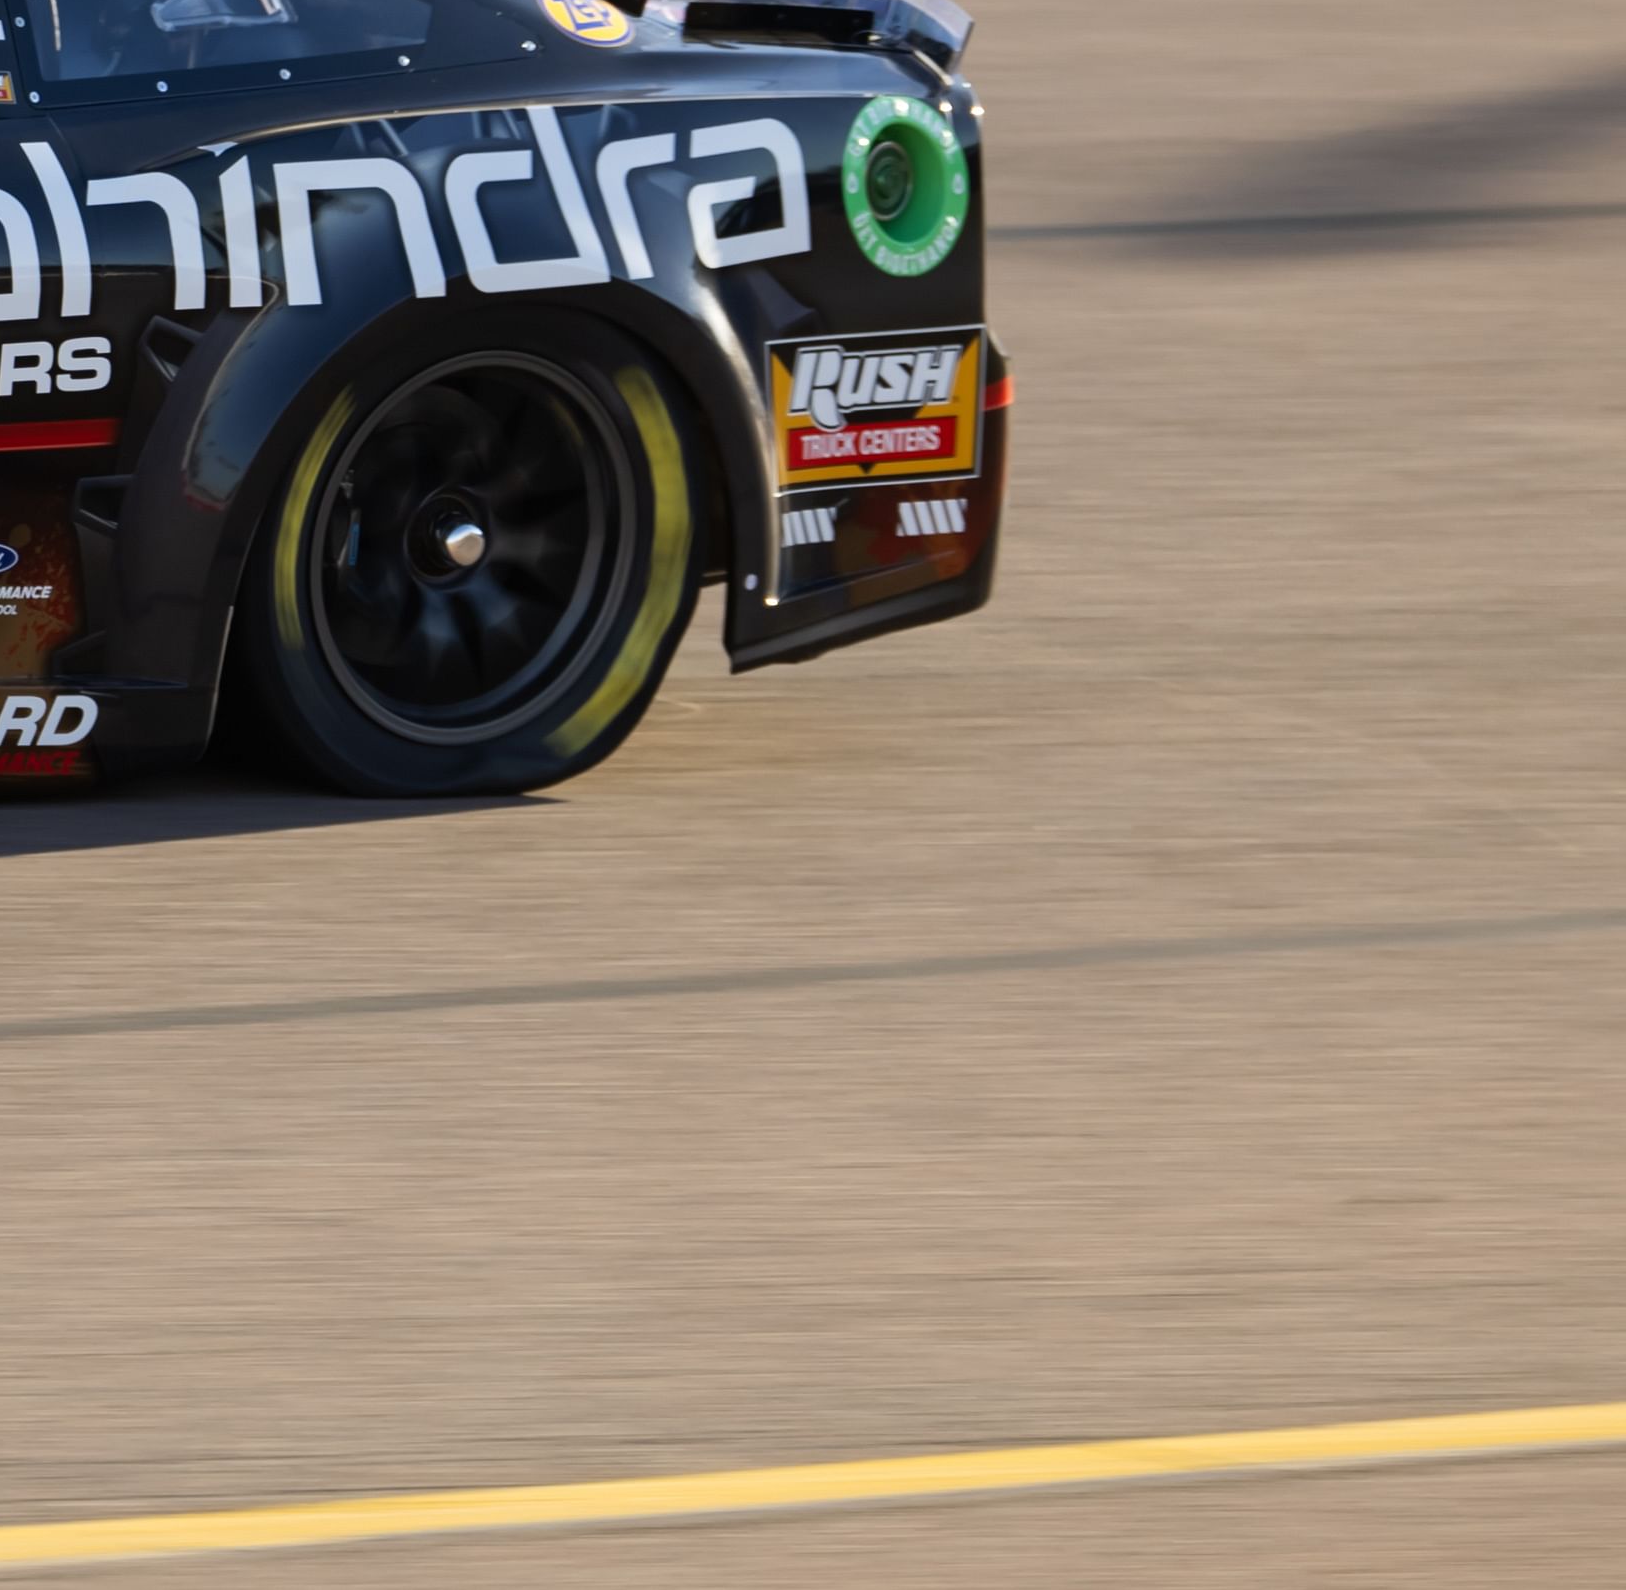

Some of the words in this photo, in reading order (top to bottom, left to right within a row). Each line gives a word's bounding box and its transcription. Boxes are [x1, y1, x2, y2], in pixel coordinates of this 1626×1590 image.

[788, 345, 963, 432] RUSH
[800, 433, 856, 460] TRUCK
[859, 425, 941, 456] CENTERS
